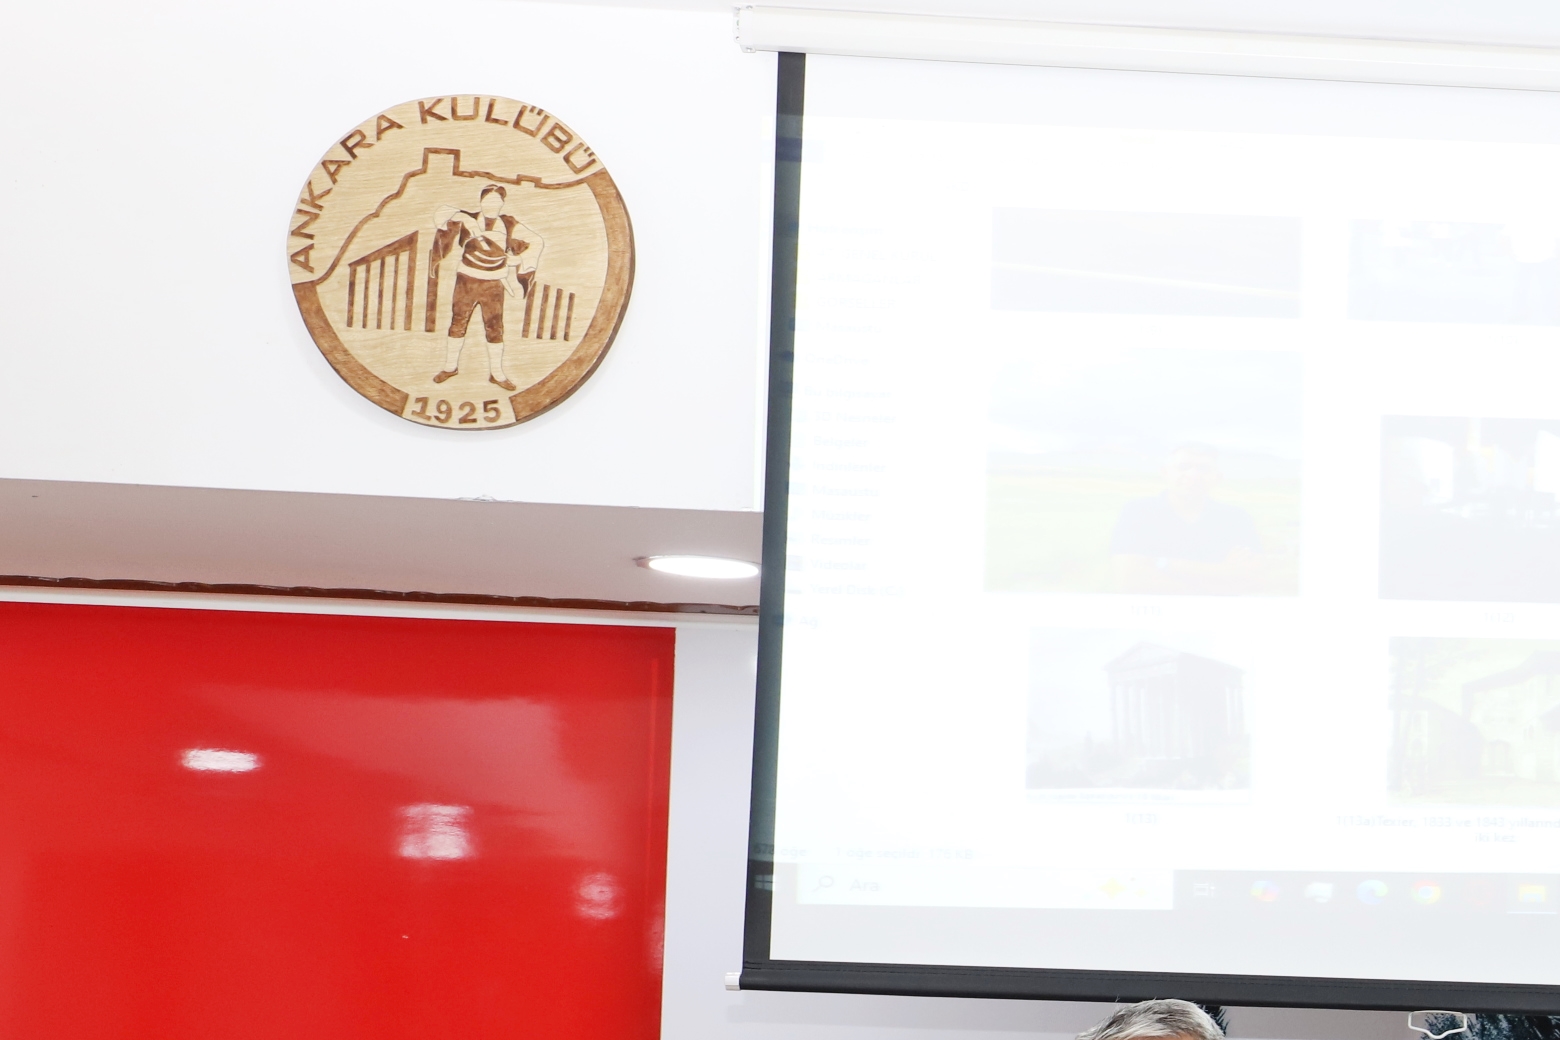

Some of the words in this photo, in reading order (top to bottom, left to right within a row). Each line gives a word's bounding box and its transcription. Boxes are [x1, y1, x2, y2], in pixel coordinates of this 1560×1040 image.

[290, 113, 406, 273] ANKARA
[417, 96, 597, 175] KULÜBÜ
[410, 396, 501, 425] 1925
